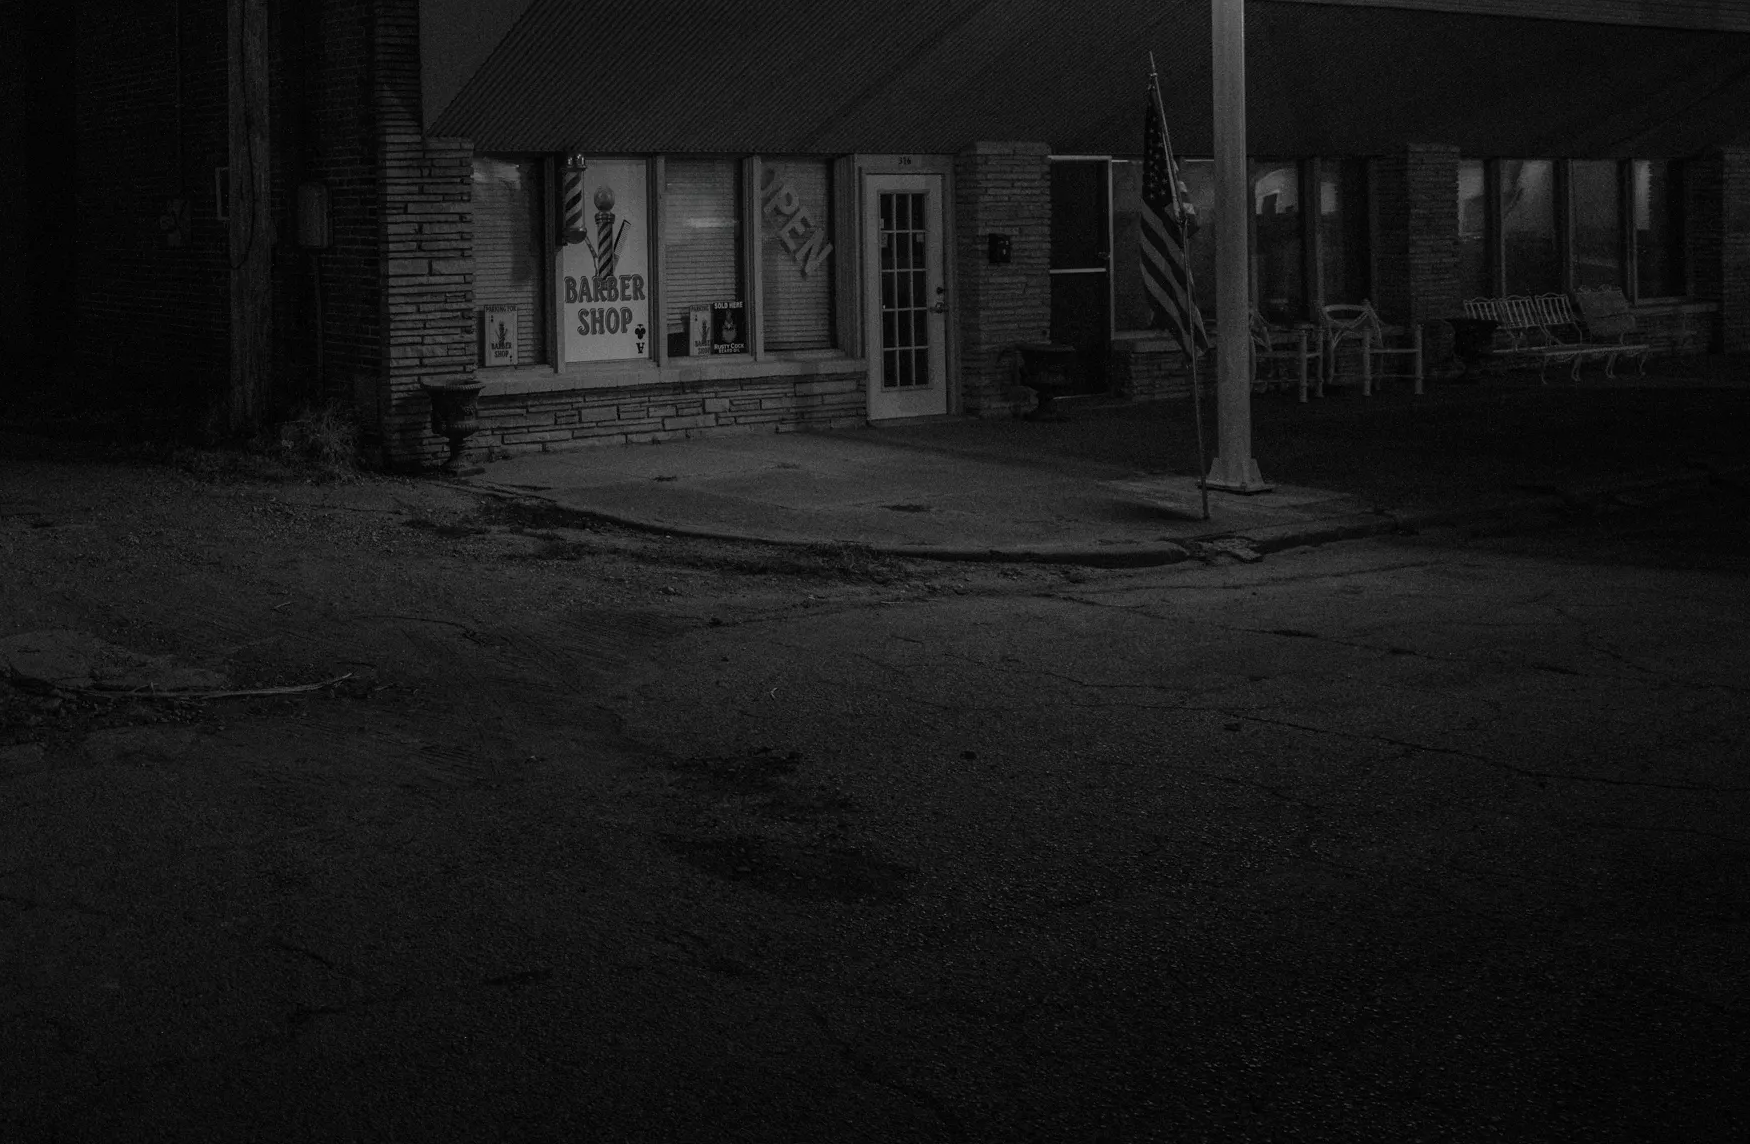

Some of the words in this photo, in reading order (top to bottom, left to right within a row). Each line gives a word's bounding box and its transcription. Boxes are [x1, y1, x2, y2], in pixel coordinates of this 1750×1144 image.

[564, 274, 646, 303] BARBER
[714, 302, 729, 310] SOLD
[577, 307, 633, 336] SHOP
[494, 350, 509, 358] SHOP
